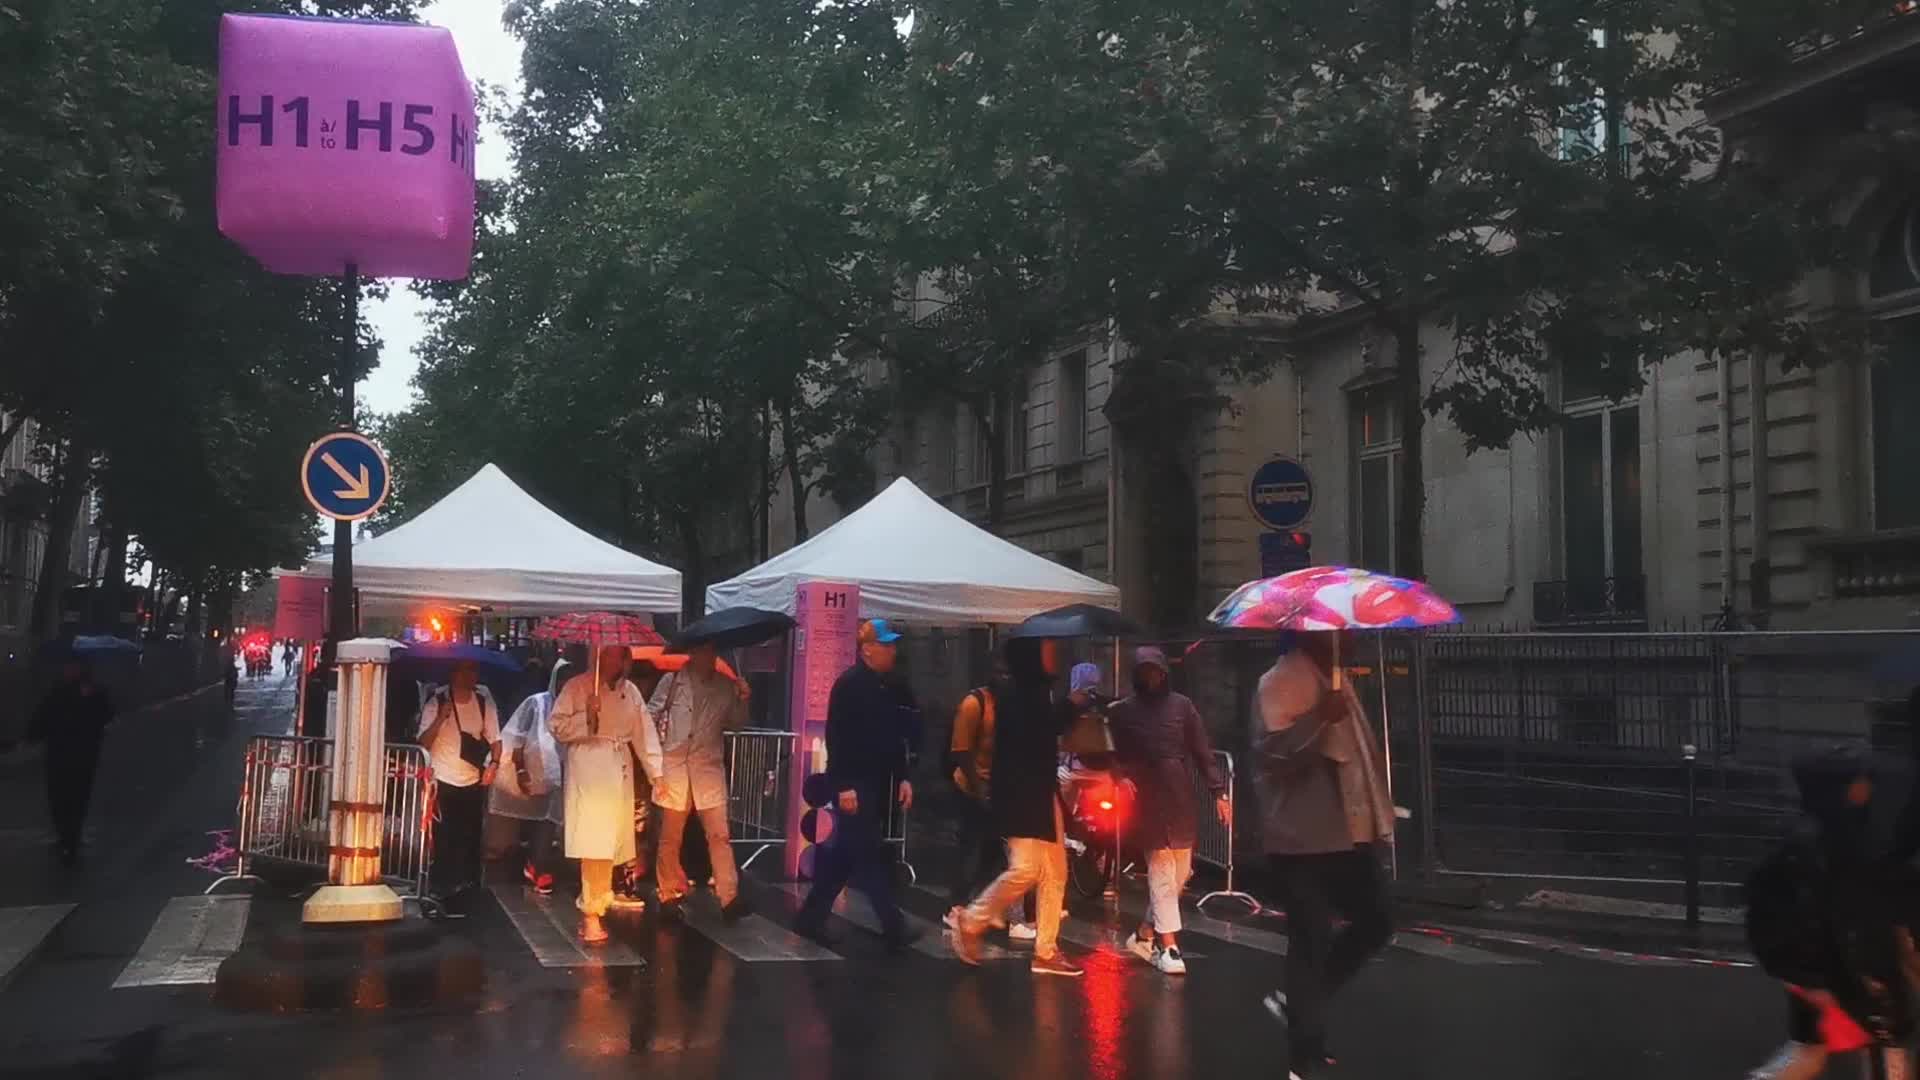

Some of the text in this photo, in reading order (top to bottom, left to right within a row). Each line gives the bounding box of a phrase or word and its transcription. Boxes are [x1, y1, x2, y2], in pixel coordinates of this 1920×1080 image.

[228, 95, 309, 148] H1
[345, 99, 435, 156] H5
[321, 137, 336, 149] to
[824, 591, 846, 609] H1
